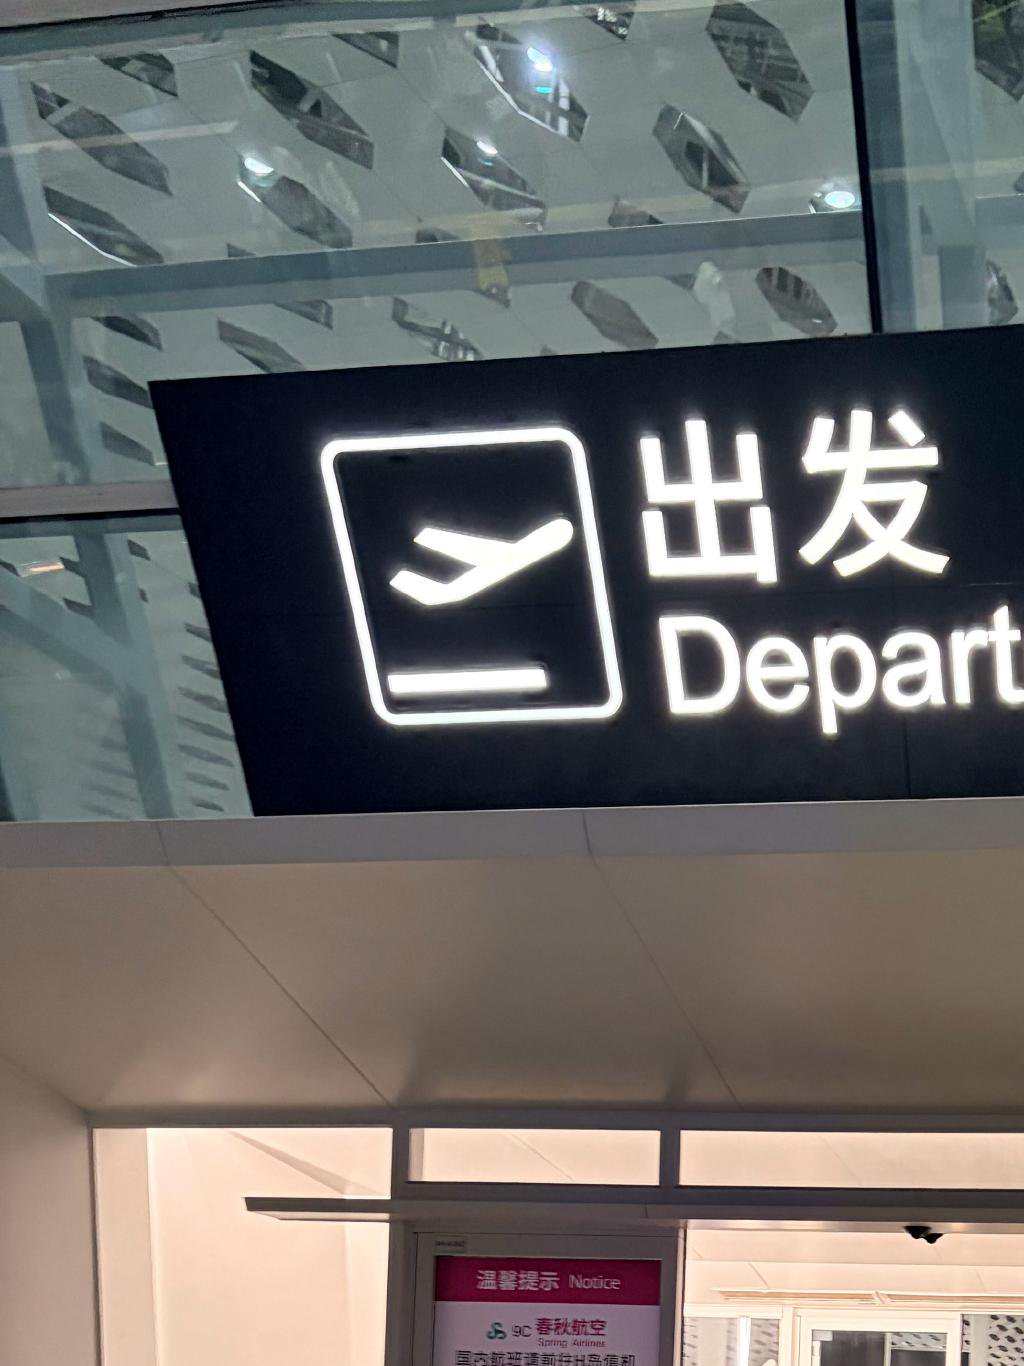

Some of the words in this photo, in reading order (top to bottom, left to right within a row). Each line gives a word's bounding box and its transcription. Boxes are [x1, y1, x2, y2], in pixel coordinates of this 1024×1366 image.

[639, 407, 950, 585] 出发
[476, 1270, 560, 1291] 温馨提示
[569, 1274, 621, 1290] Notice
[512, 1325, 532, 1338] 9C
[535, 1317, 607, 1337] 春秋航空
[538, 1337, 568, 1348] Spring
[573, 1338, 606, 1348] Airlines
